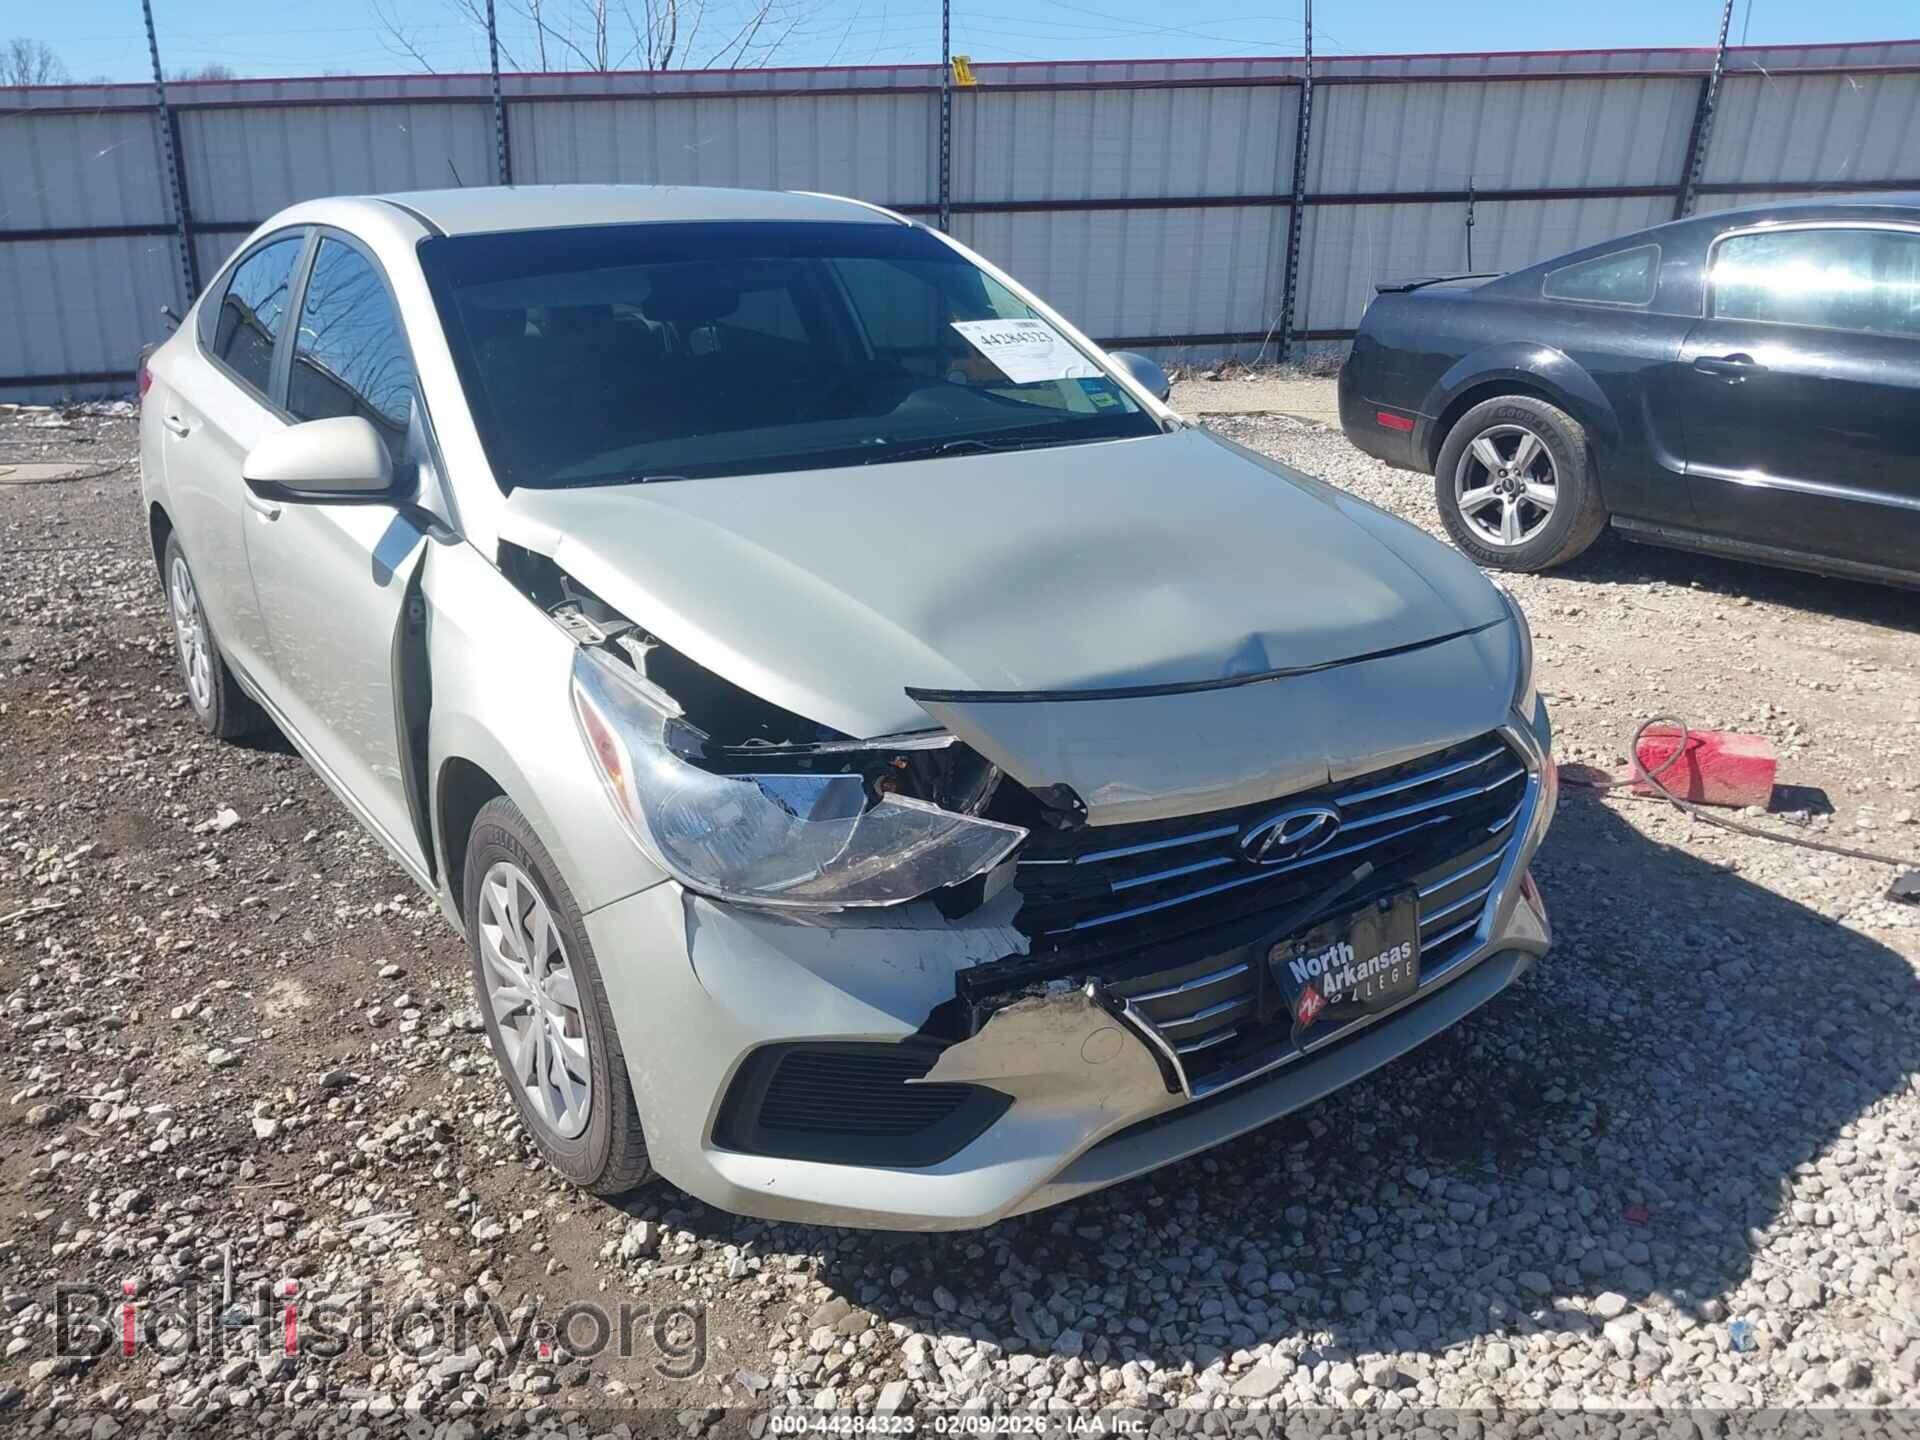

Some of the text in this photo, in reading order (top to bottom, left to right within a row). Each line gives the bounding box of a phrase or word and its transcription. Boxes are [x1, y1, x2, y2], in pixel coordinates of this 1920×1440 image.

[980, 331, 1053, 345] 44284323
[1289, 942, 1354, 983] North
[1323, 942, 1412, 997] Arkansas
[1330, 961, 1412, 1004] OLLEGE
